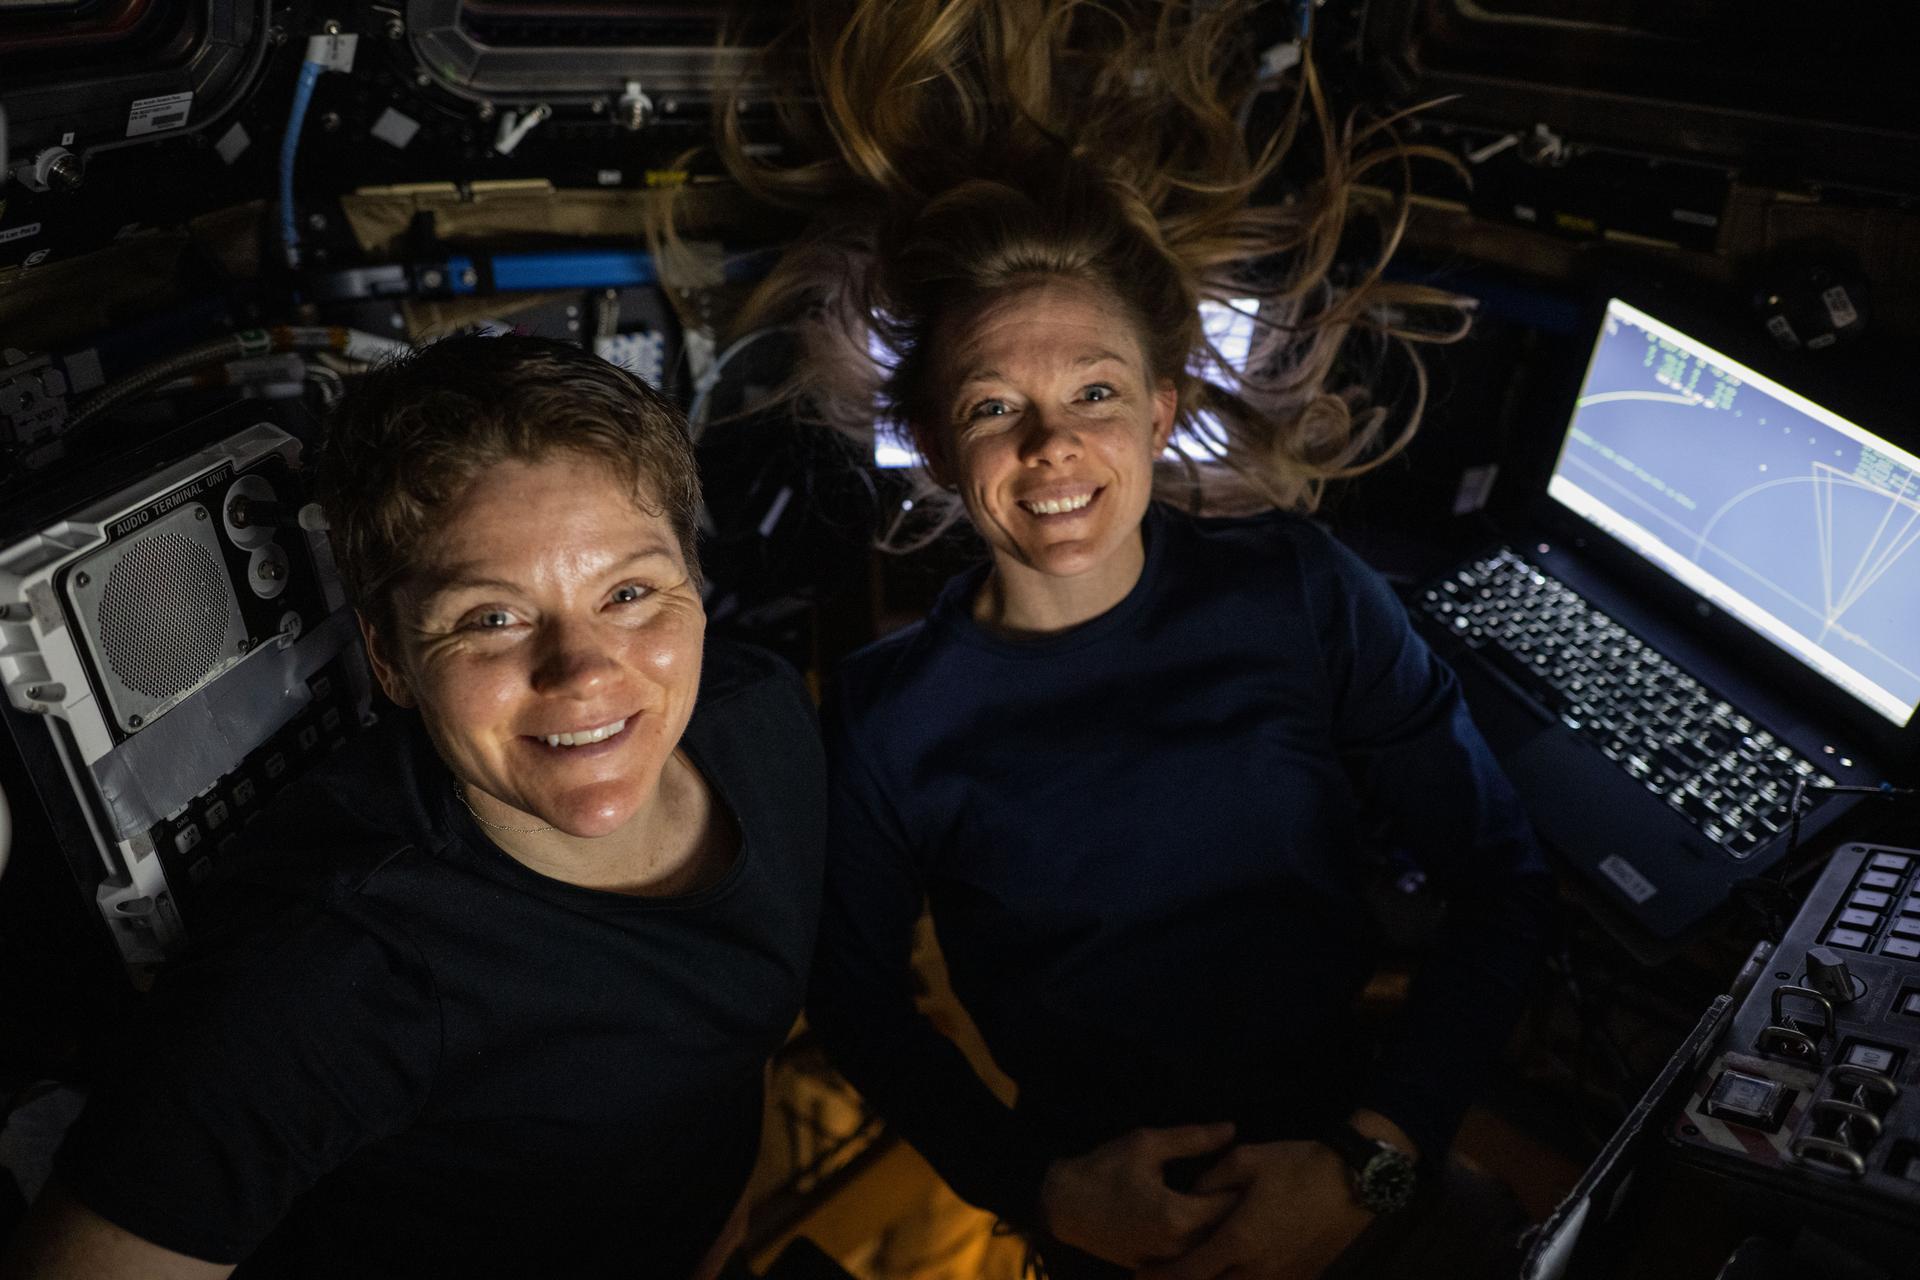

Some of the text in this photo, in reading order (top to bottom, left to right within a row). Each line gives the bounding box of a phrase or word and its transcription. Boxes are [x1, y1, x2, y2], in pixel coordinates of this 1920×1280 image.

[116, 469, 228, 536] AUDIO TERMINAL UNIT
